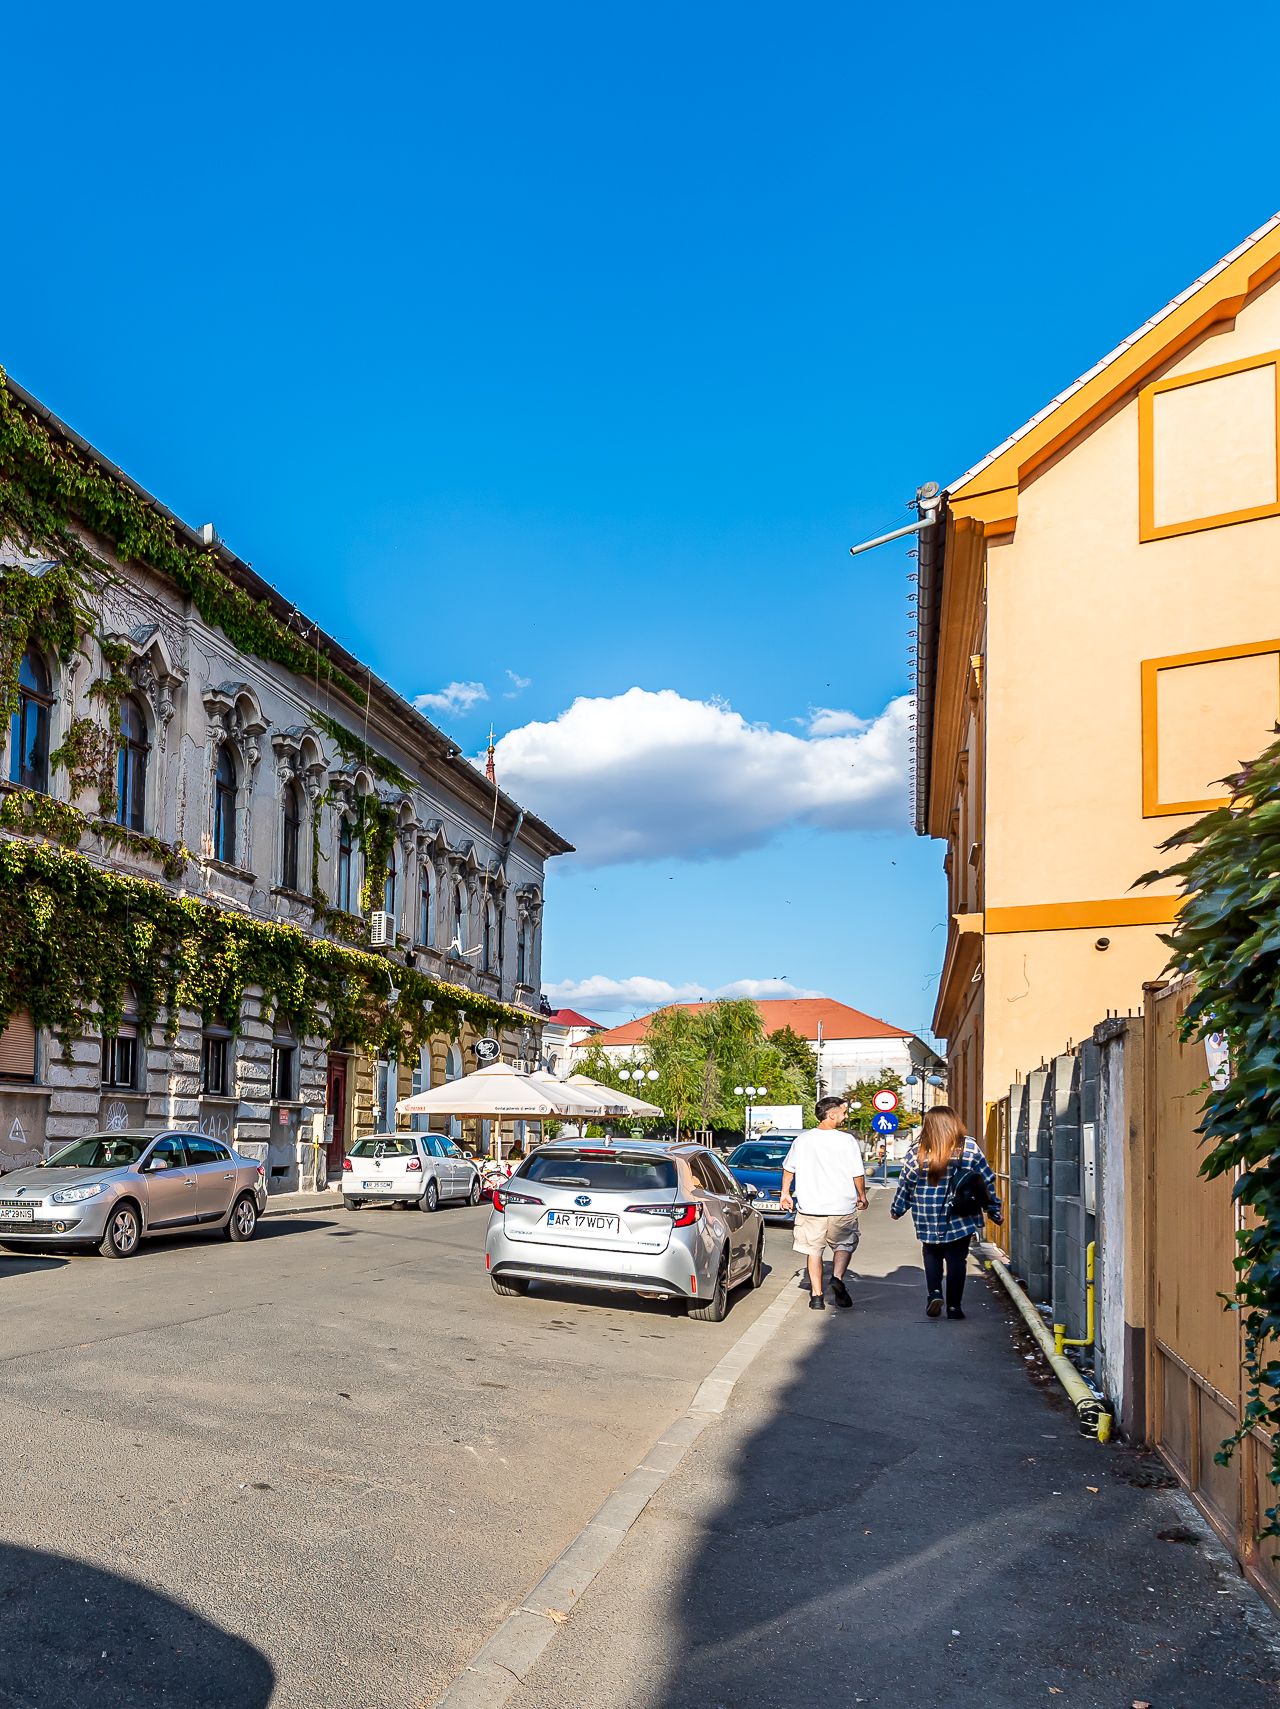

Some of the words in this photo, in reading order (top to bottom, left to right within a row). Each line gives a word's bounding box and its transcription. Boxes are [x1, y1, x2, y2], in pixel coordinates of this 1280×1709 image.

[1, 1210, 10, 1218] AR
[555, 1215, 570, 1226] AR
[575, 1216, 586, 1226] 17
[587, 1217, 614, 1229] WDY
